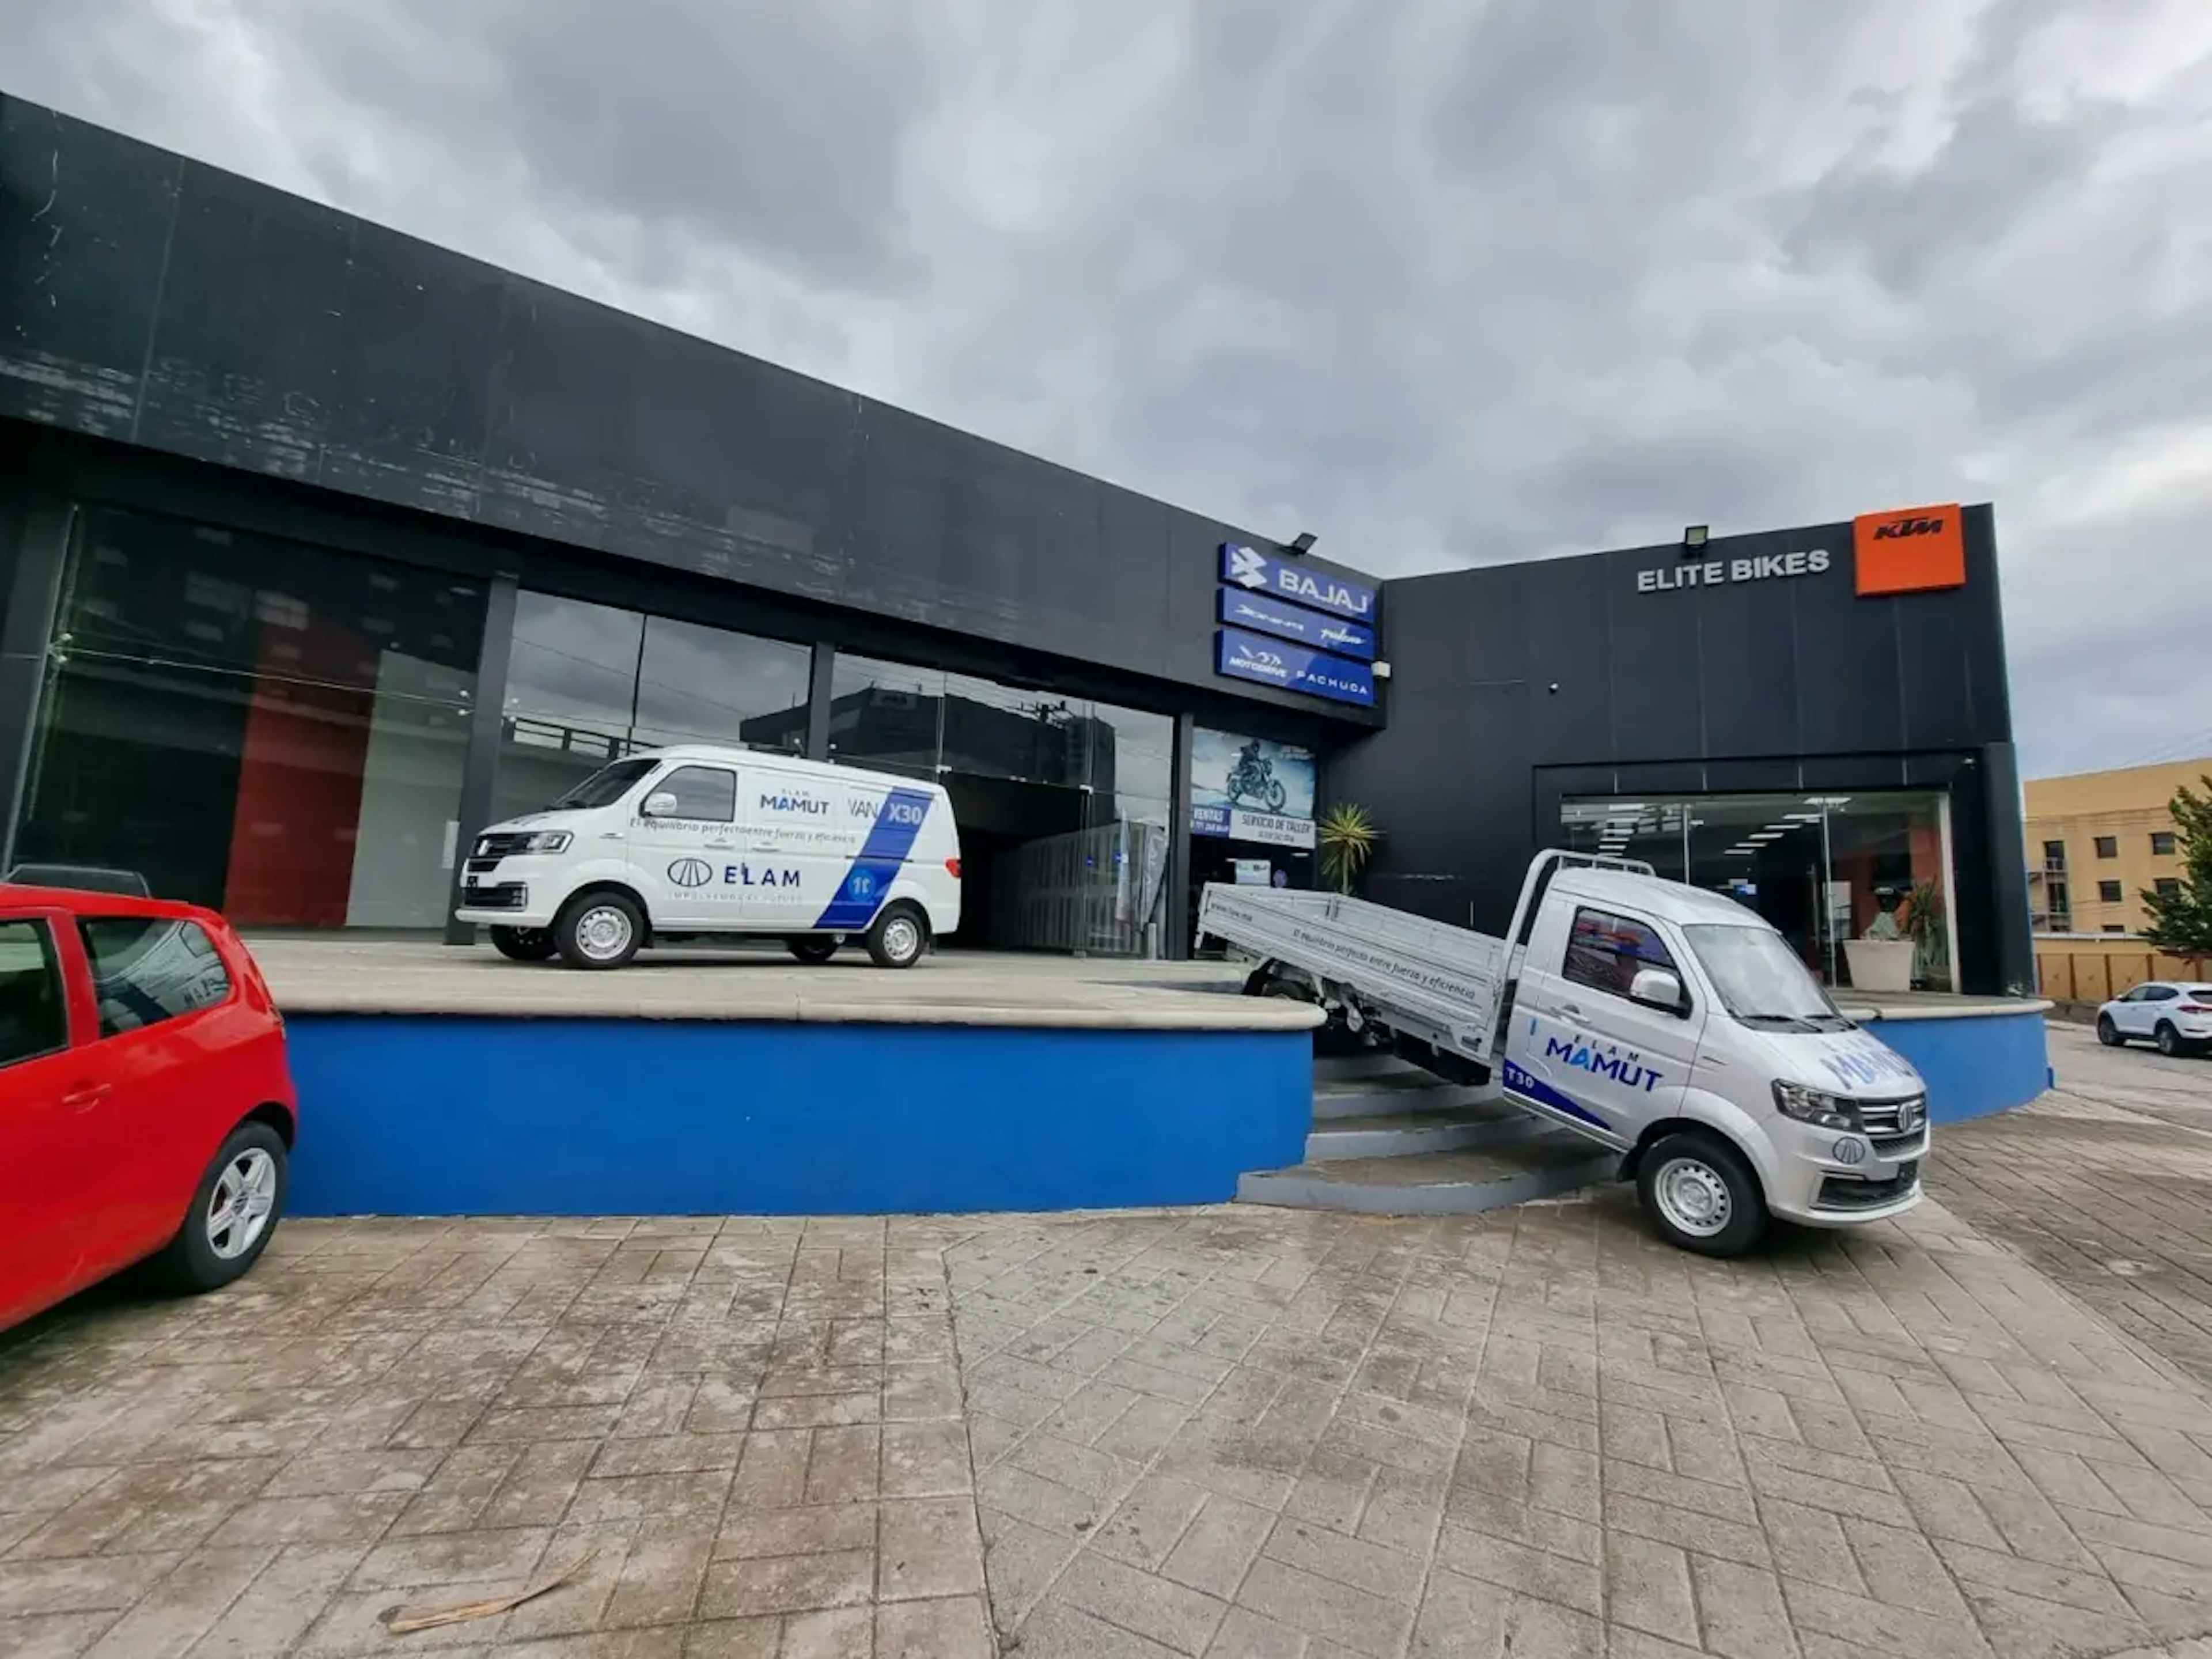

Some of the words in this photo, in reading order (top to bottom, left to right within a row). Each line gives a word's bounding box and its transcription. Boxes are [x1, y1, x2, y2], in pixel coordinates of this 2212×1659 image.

[1873, 518, 1943, 540] KTM
[1637, 561, 1724, 593] ELITE
[1732, 550, 1830, 581] BIKES
[1278, 568, 1368, 613] BAJAJ
[1296, 670, 1368, 695] PACHUCA
[760, 794, 830, 815] MAMUT
[847, 798, 879, 819] VAN
[888, 803, 922, 825] X30
[724, 862, 800, 888] ELAM
[1574, 1035, 1638, 1062] ELAM
[1546, 1037, 1663, 1092] MAMUT
[1507, 1068, 1535, 1089] T30
